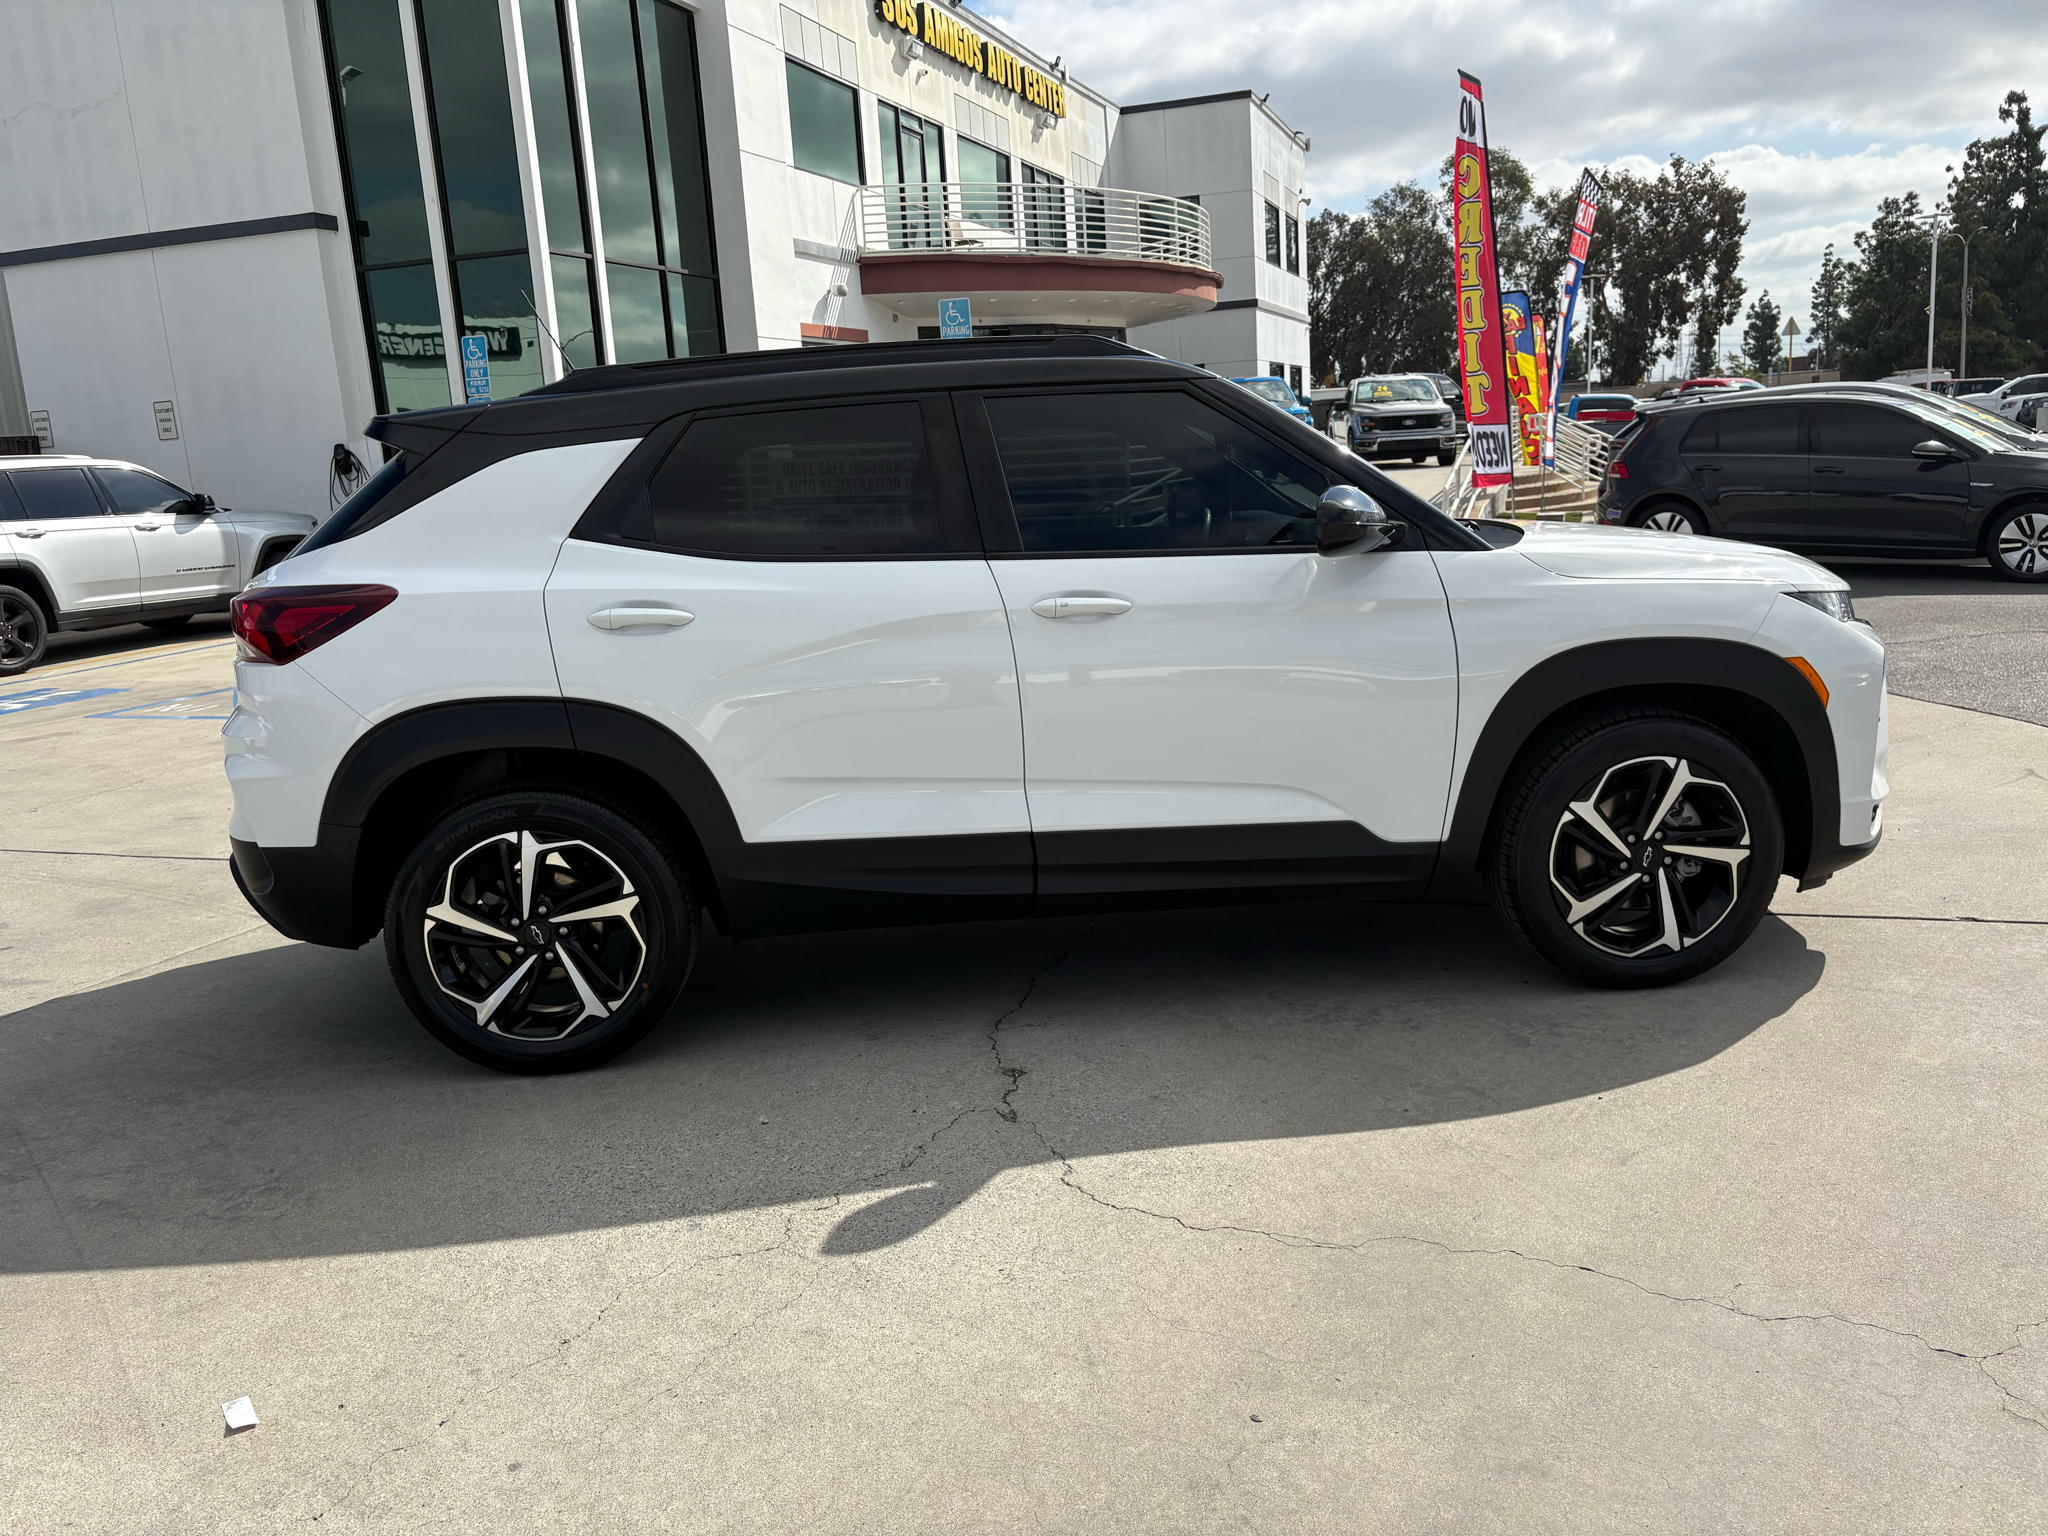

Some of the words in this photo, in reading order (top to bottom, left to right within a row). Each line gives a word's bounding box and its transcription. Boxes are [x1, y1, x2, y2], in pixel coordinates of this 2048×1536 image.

[923, 2, 983, 73] AMIGOS
[987, 41, 1022, 94] AUTO
[1024, 65, 1067, 119] CENTER
[942, 325, 970, 336] PARKING
[465, 359, 487, 369] PARKING
[470, 369, 484, 378] ONLY
[782, 461, 815, 477] DRIVE
[819, 460, 846, 476] SAFE
[775, 480, 784, 495] &
[788, 479, 816, 495] AUTO
[820, 477, 901, 494] REGISTRATION
[812, 506, 848, 518] VALLEY
